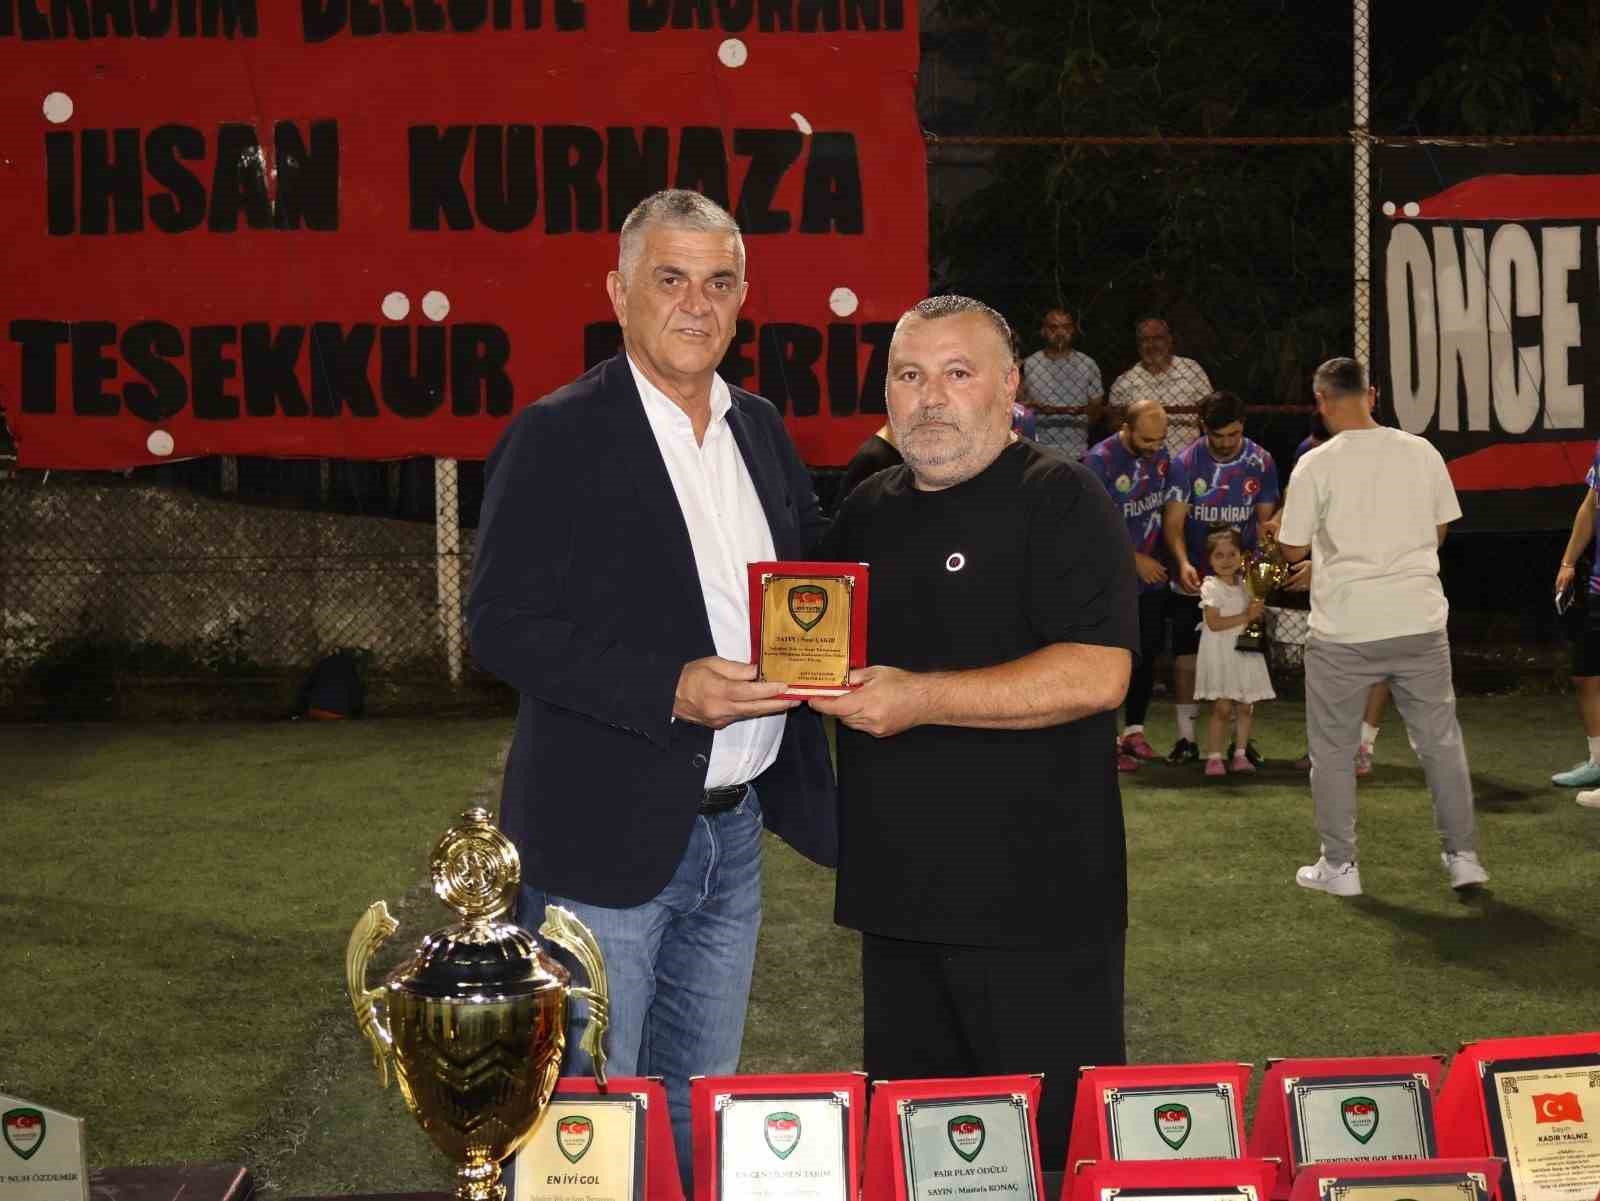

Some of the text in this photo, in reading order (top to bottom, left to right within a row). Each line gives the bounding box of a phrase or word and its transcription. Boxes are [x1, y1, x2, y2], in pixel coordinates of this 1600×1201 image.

[44, 92, 339, 236] İHSAN
[1377, 201, 1585, 434] ÖNCE
[9, 290, 513, 456] TEŞEKKÜR
[1195, 503, 1218, 521] FİLO
[546, 1172, 600, 1184] EN İYİ GOL
[954, 1168, 975, 1177] PLAY
